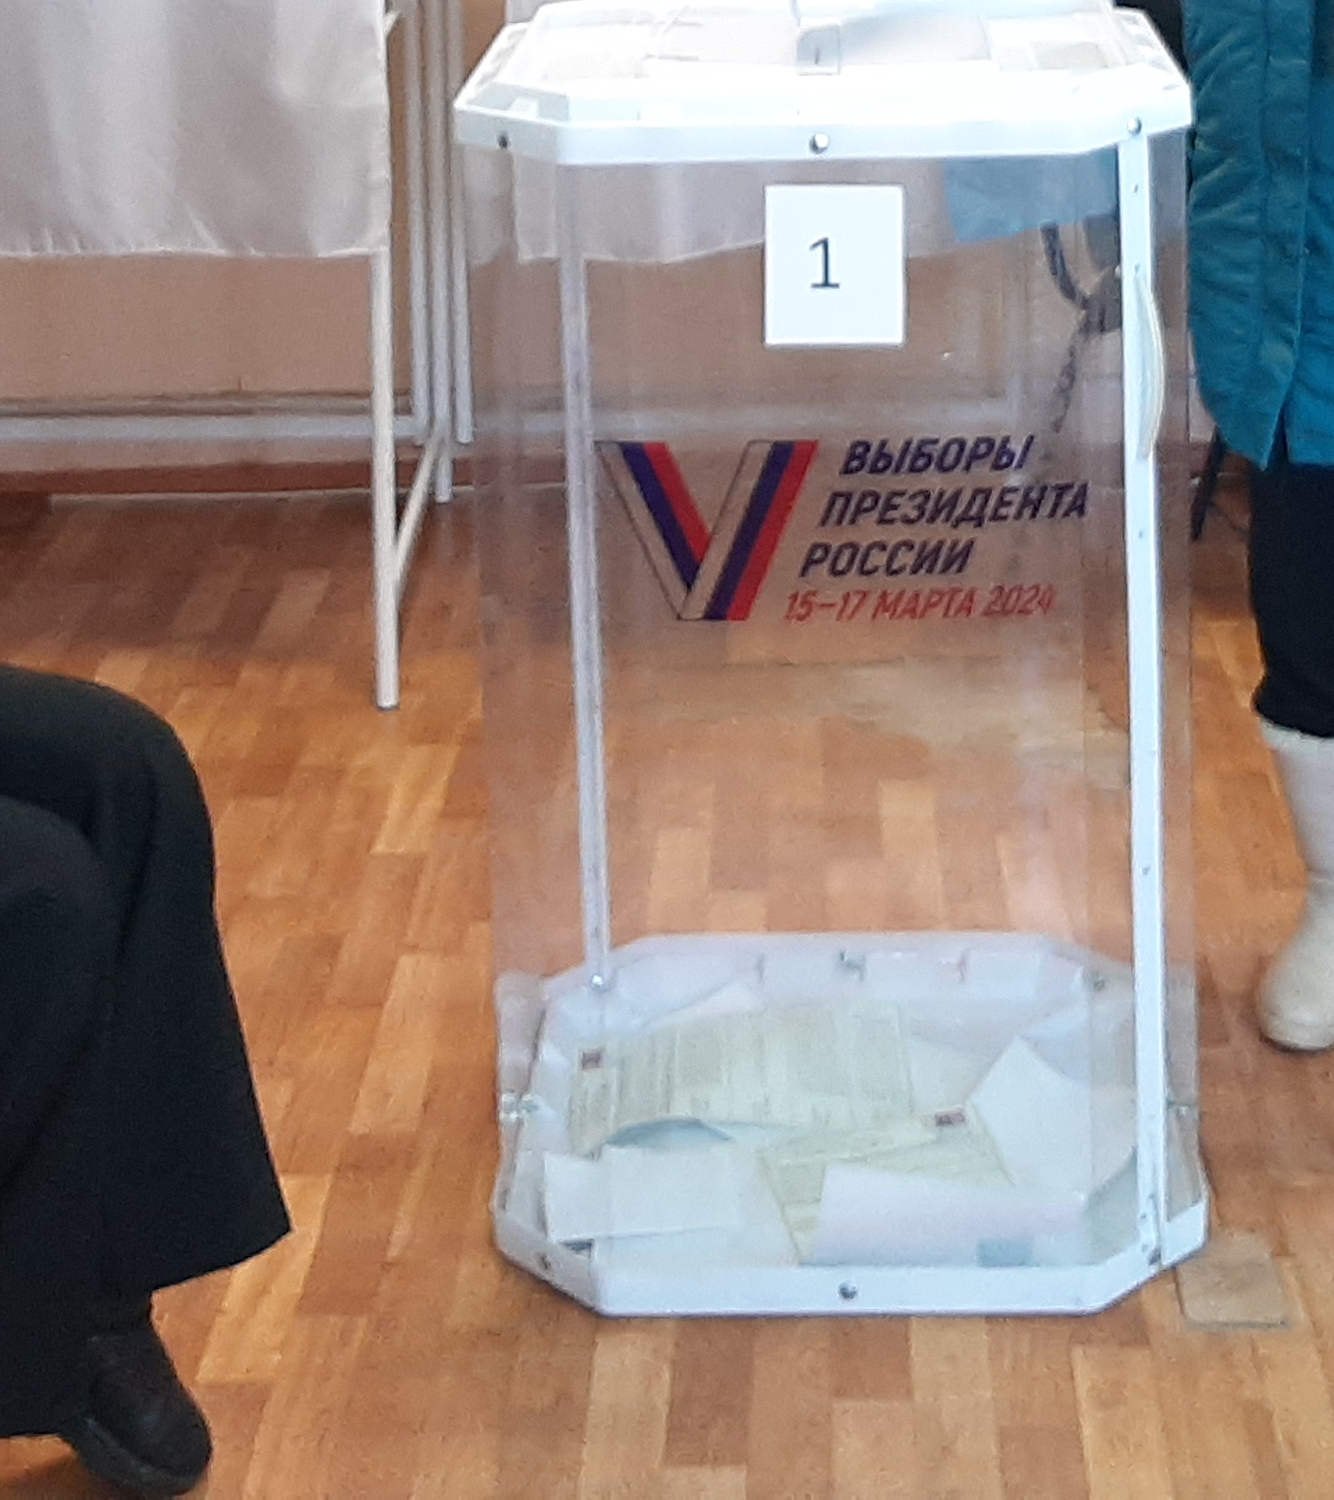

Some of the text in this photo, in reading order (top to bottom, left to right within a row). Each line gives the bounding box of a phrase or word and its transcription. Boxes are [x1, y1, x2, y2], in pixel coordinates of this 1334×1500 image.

[809, 236, 841, 289] 1
[840, 436, 1034, 475] ВЫБОРЫ
[819, 484, 1089, 527] ПРЕЗИДЕНТА
[800, 539, 975, 578] РОССИИ
[871, 586, 978, 620] МАРТА
[981, 584, 1057, 617] 2024
